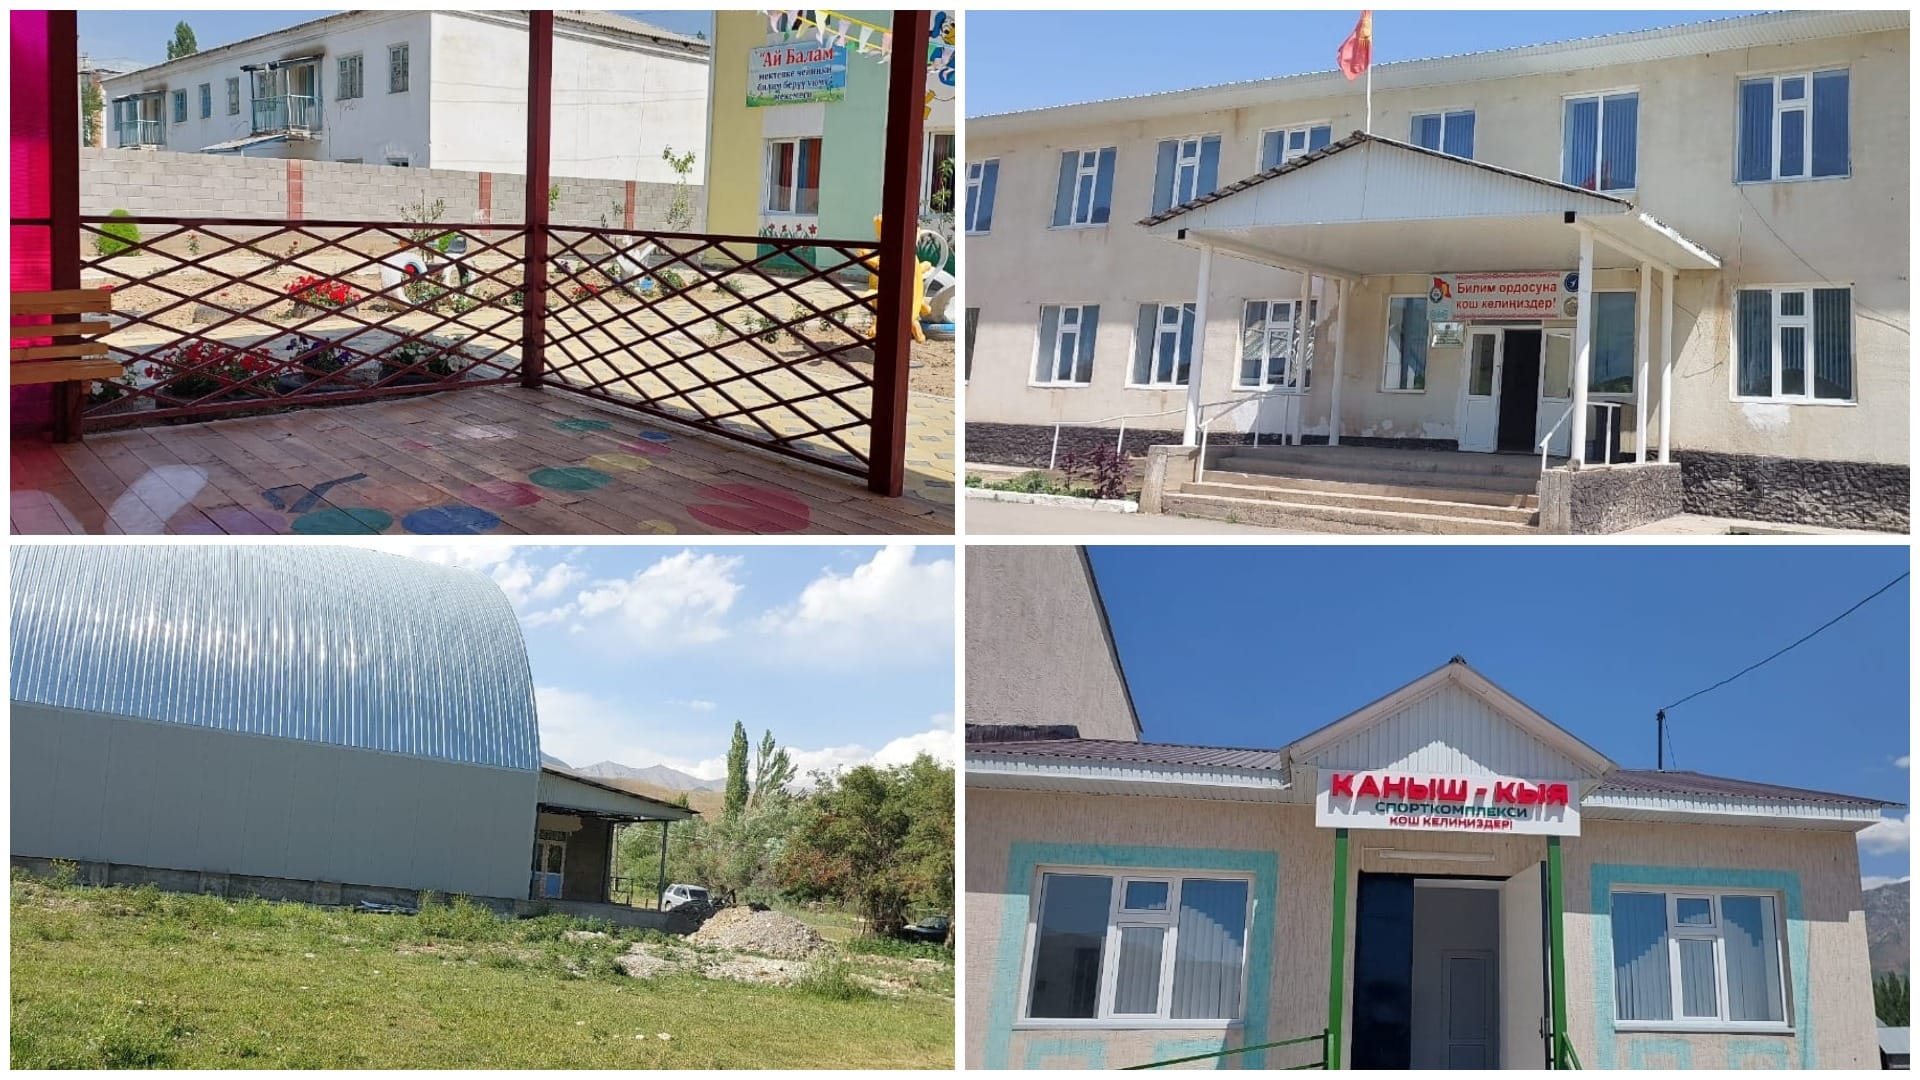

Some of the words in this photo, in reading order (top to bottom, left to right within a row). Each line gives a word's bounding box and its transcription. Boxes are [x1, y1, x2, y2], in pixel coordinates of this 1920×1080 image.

[786, 48, 834, 65] Балам
[1457, 282, 1496, 294] Билим
[1500, 282, 1557, 295] ордосуна
[1456, 301, 1478, 310] кош
[1482, 298, 1556, 311] келиңиздер!
[1331, 773, 1468, 803] КАНЫШ
[1494, 780, 1569, 806] КЫЯ
[1375, 801, 1528, 818] СПОРТКОМПЛЕКСИ
[1389, 816, 1420, 826] КОШ
